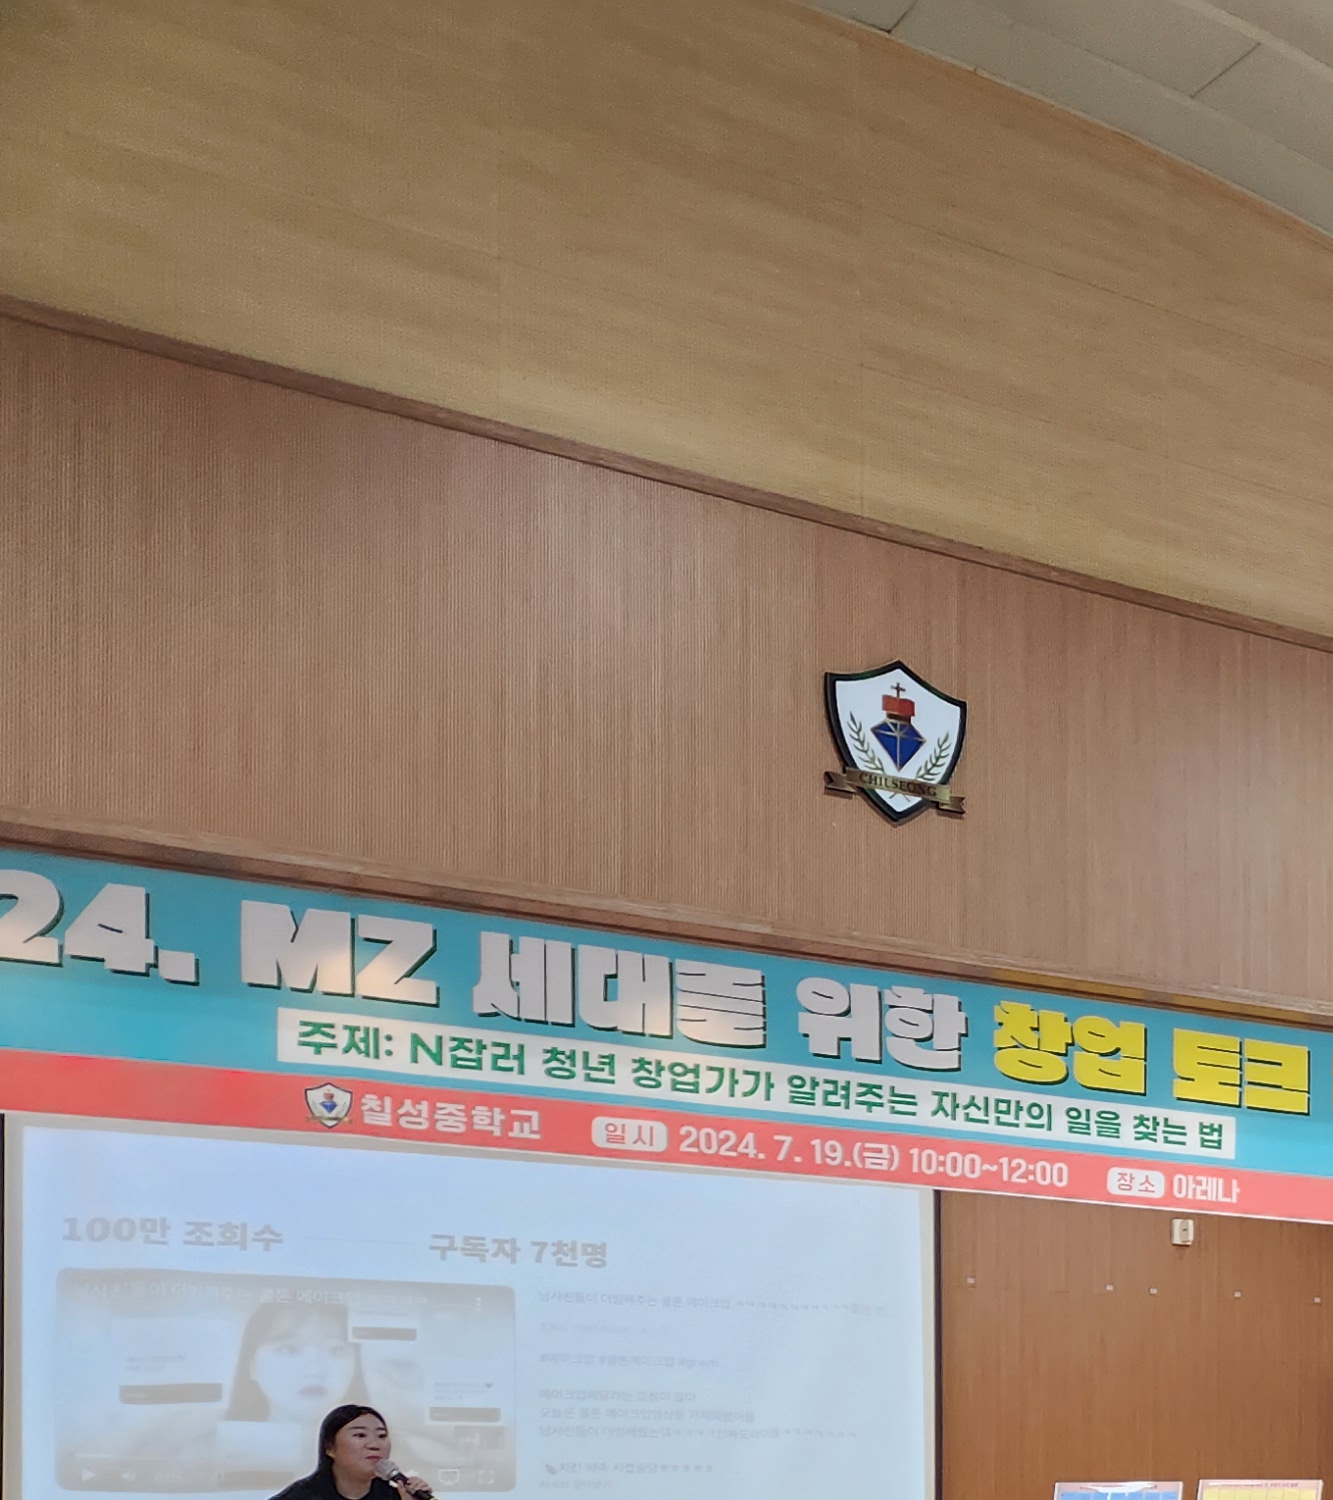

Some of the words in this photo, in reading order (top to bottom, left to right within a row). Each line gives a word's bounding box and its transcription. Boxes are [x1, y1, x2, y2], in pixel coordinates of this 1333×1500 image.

[859, 773, 938, 797] CHILSEONG
[0, 869, 199, 984] 24.
[241, 900, 440, 1007] MZ
[473, 931, 767, 1048] 세대를
[796, 977, 967, 1071] 위한
[993, 1000, 1147, 1096] 창업
[1172, 1028, 1310, 1115] 토크
[298, 1020, 393, 1060] 주제:
[410, 1033, 526, 1076] N잡러
[541, 1046, 617, 1086] 청년
[631, 1056, 775, 1101] 창업가가
[787, 1073, 918, 1117] 알려주는
[930, 1088, 1053, 1132] 자신만의
[1064, 1105, 1121, 1139] 일을
[1132, 1114, 1187, 1145] 찾는
[1198, 1121, 1224, 1151] 법
[360, 1093, 542, 1140] 칠성중학교
[603, 1122, 655, 1148] 일시
[679, 1125, 766, 1159] 2024.
[774, 1134, 802, 1163] 7.
[810, 1137, 900, 1171] 19.(금)
[909, 1147, 1068, 1187] 10:00~12:00
[1115, 1172, 1155, 1195] 장소
[1172, 1174, 1241, 1204] 아레나
[62, 1217, 170, 1246] 100만
[184, 1220, 284, 1252] 조회수
[429, 1234, 521, 1264] 구독자
[530, 1239, 608, 1269] 7천명
